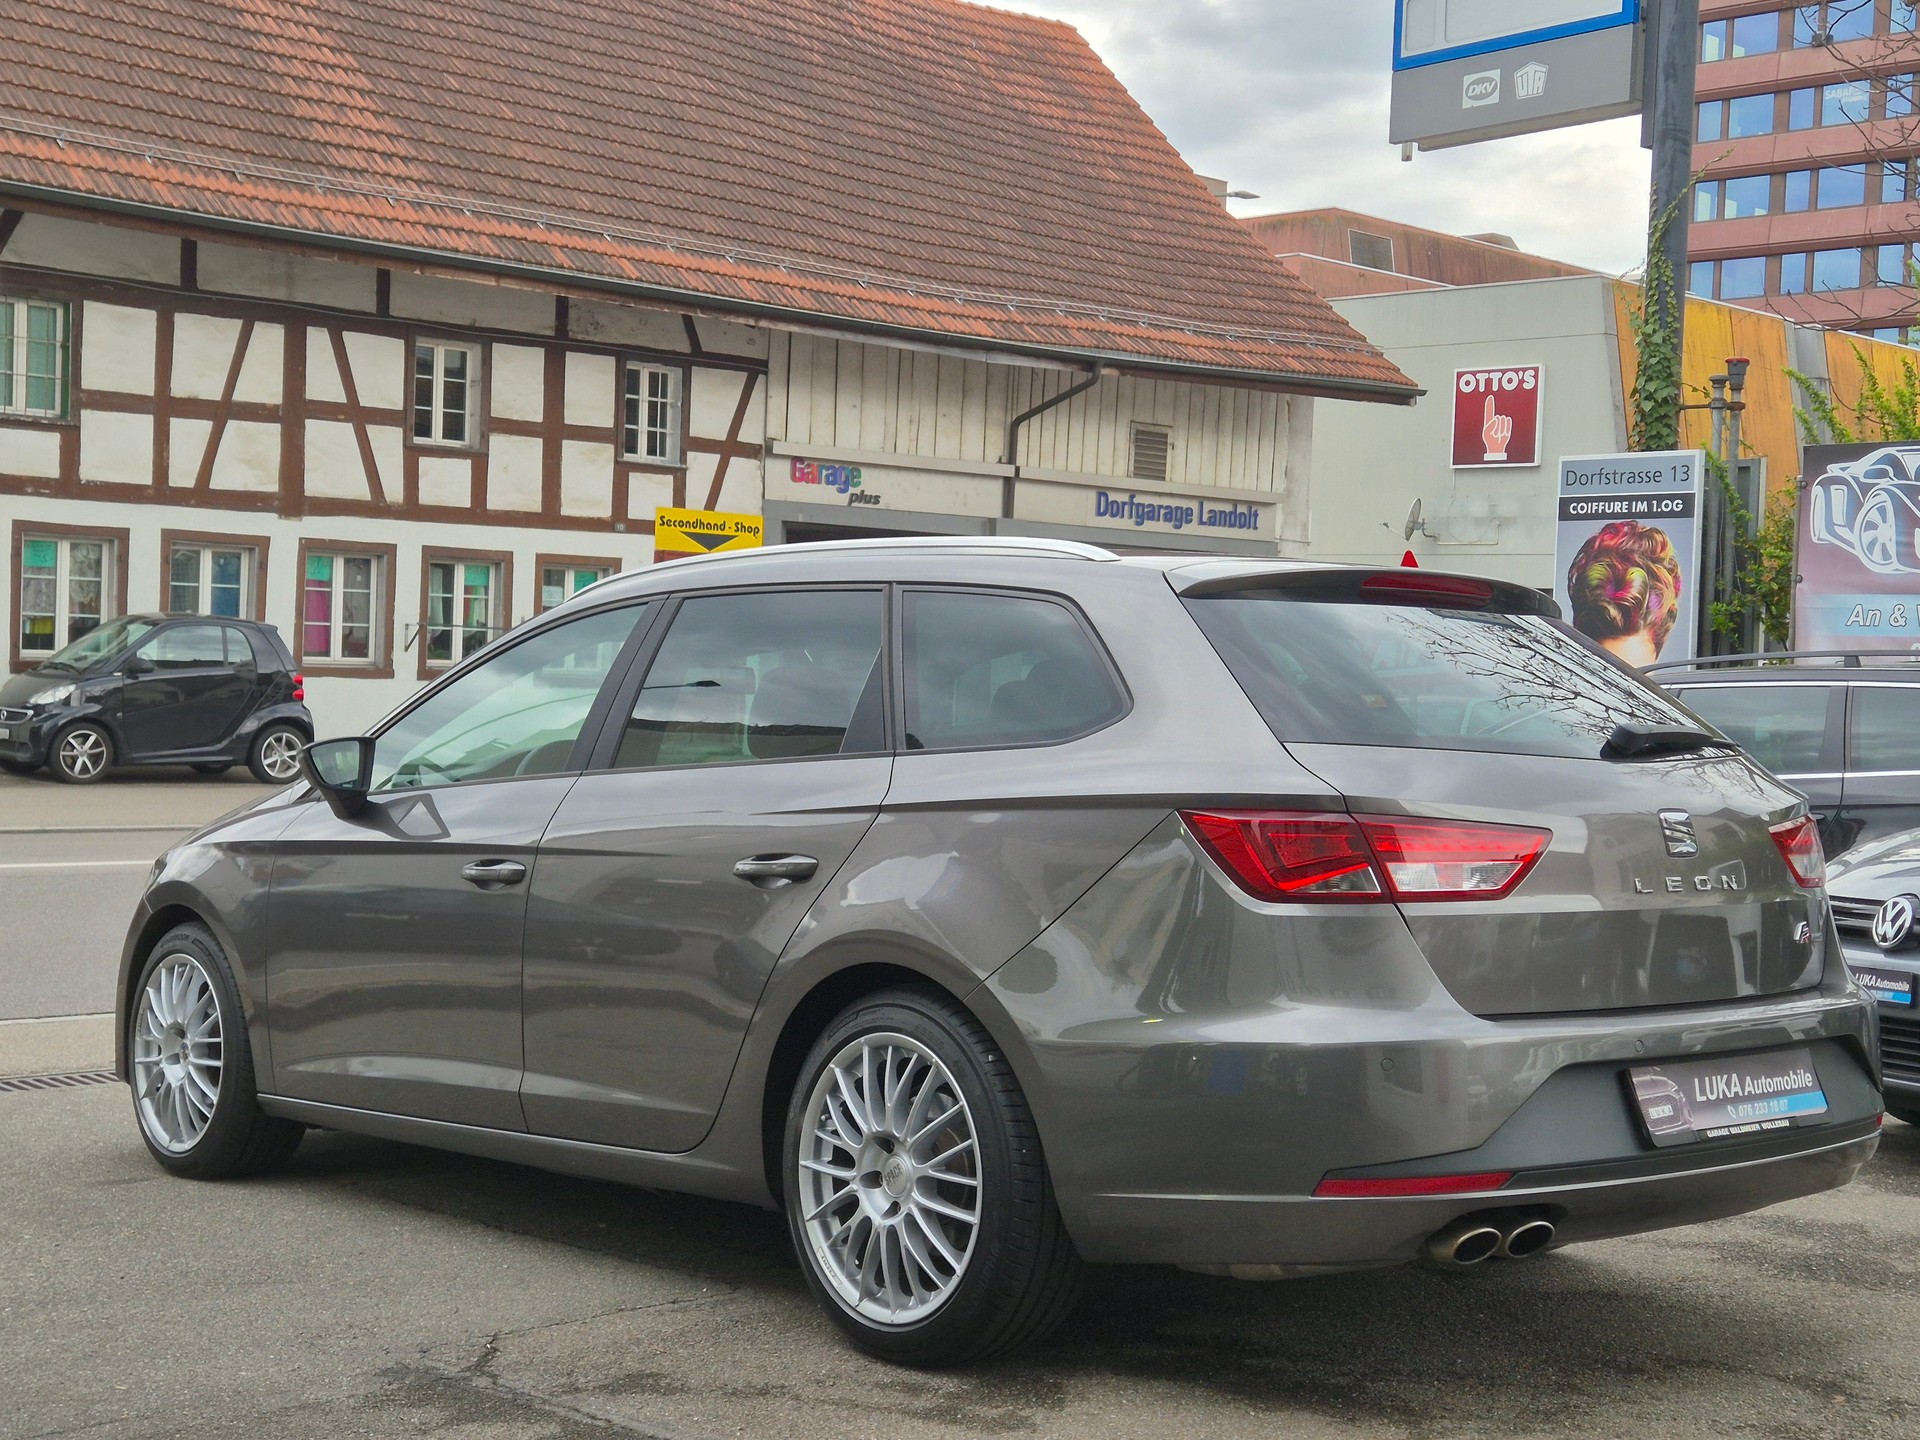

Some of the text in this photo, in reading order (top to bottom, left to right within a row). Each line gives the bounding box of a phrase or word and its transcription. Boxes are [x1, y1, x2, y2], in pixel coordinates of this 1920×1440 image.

[1467, 80, 1496, 96] DKV
[1515, 63, 1547, 98] UTA
[1459, 370, 1536, 393] OTTO'S
[790, 456, 862, 494] Garage
[1565, 464, 1690, 486] Dorfstrasse 13
[847, 489, 881, 507] plus
[1569, 499, 1683, 515] COIFFURE IM 1.OG
[1095, 491, 1259, 531] Dorfgarage Landolt
[659, 515, 726, 532] Secondhand
[734, 521, 760, 537] Shop
[1845, 603, 1882, 627] An
[1888, 603, 1908, 627] &
[1634, 874, 1738, 894] LEON
[1876, 978, 1910, 991] Automobile
[1694, 1069, 1813, 1102] LUKA Automobile
[1738, 1099, 1788, 1117] 076 233 18 07
[1707, 1128, 1730, 1138] GARAGE
[884, 1163, 902, 1186] SPACE
